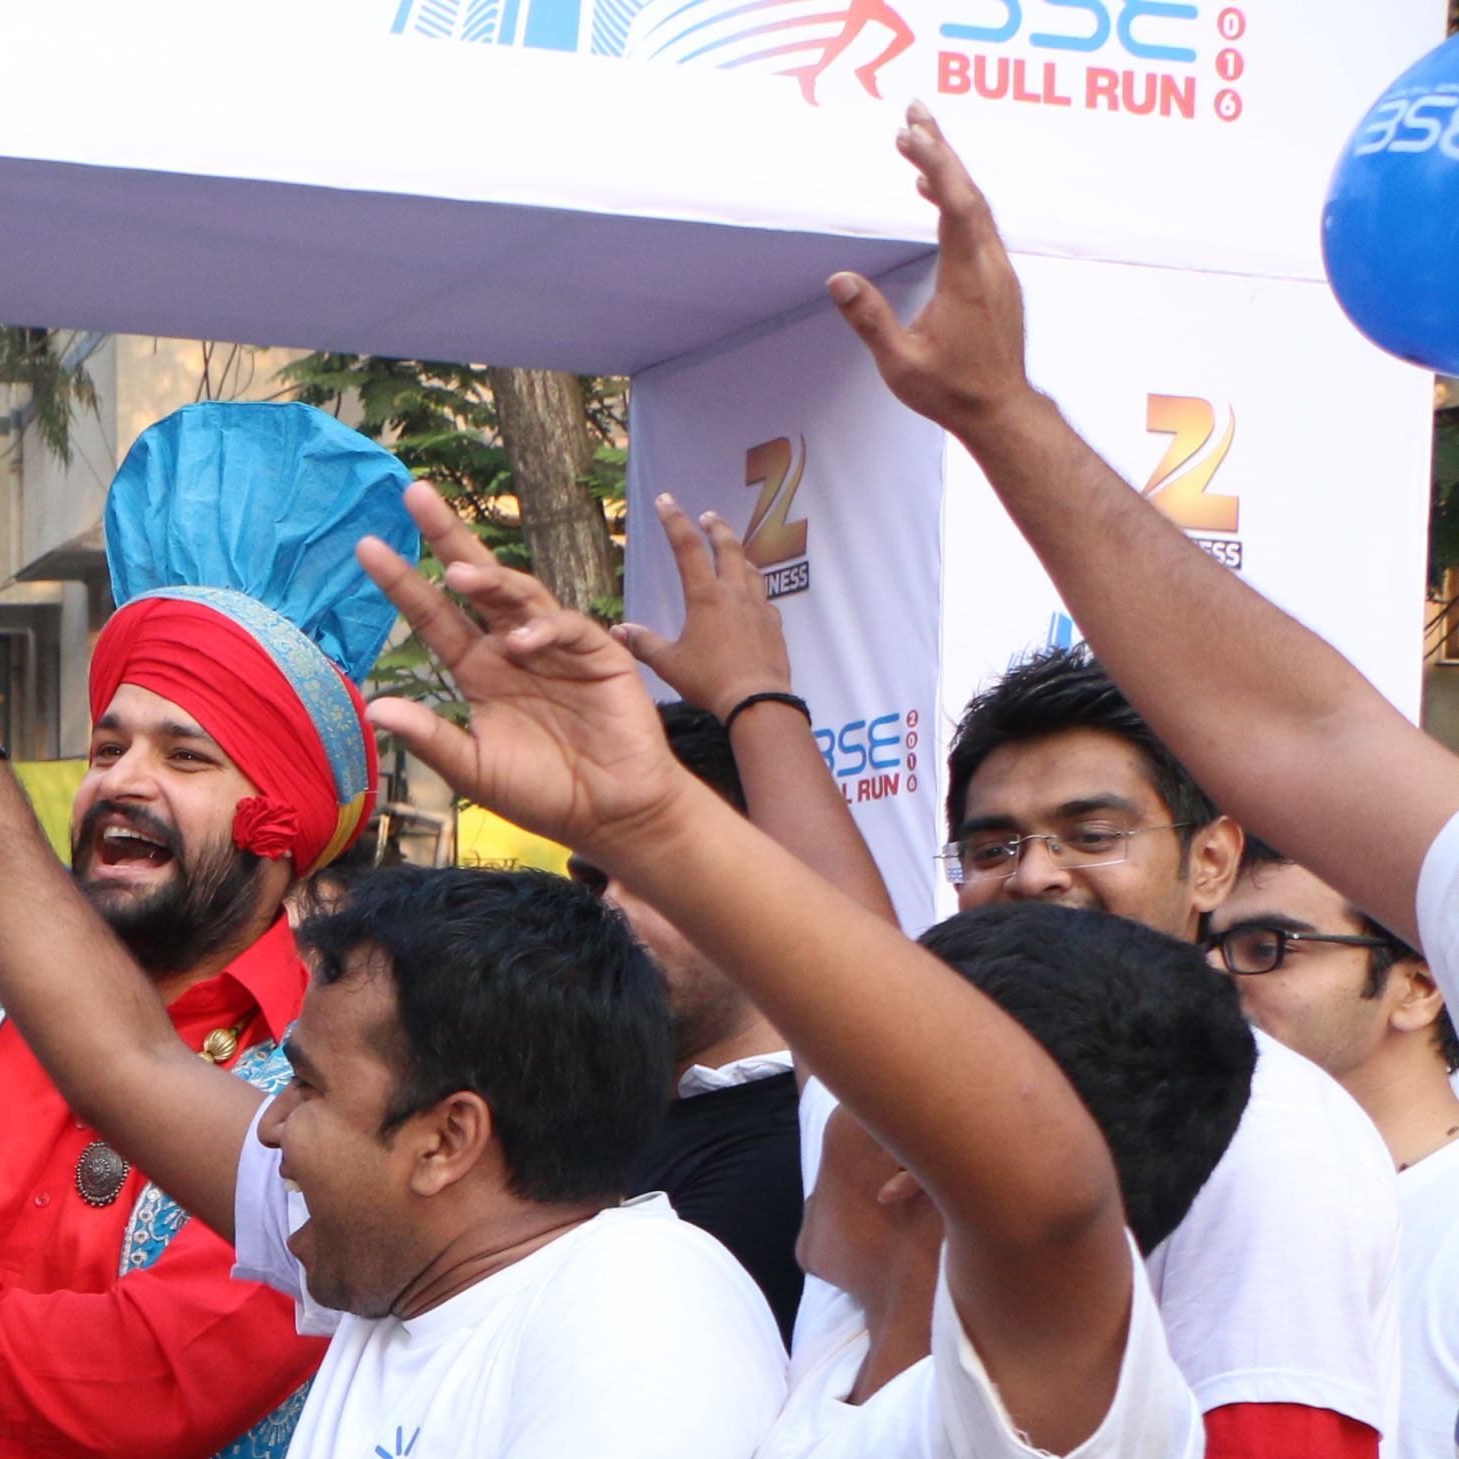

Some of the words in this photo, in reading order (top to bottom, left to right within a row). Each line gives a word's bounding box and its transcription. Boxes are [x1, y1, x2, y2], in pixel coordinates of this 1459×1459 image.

[938, 51, 1072, 106] BULL
[1085, 66, 1197, 119] RUN
[1213, 2, 1246, 122] 016
[767, 563, 809, 597] NESS
[857, 774, 900, 803] RUN
